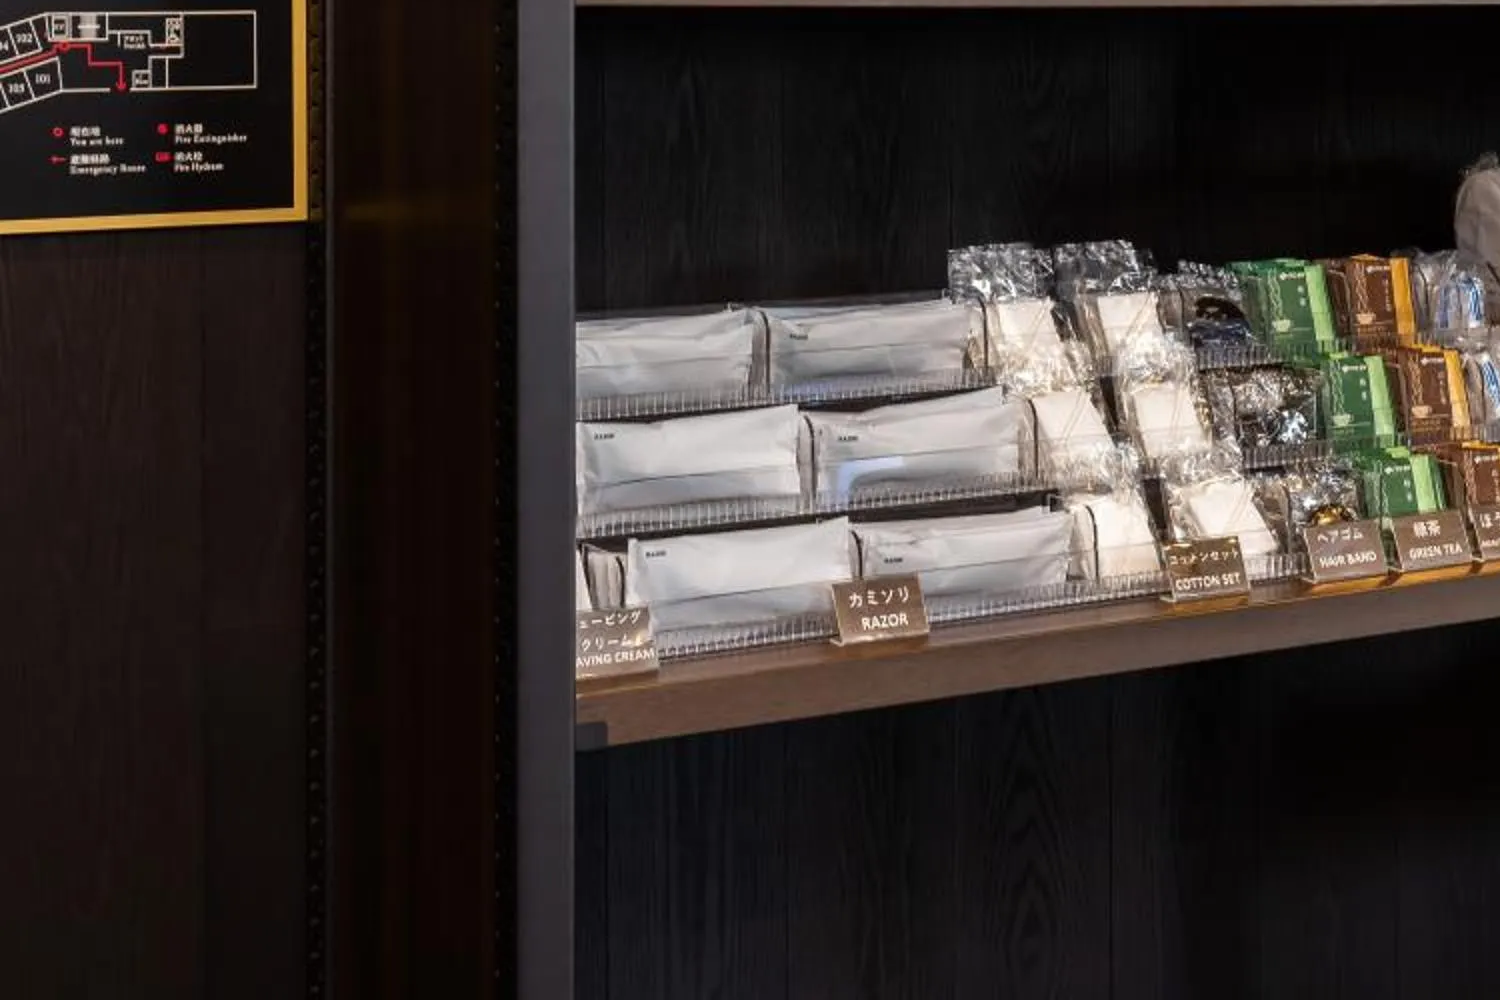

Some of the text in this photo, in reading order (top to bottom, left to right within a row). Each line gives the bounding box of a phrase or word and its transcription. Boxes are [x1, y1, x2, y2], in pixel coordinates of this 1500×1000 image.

[1317, 527, 1363, 543] ヘアゴム
[1409, 541, 1463, 560] GREEN TEA
[1319, 555, 1346, 568] HAIR
[1175, 571, 1241, 590] COTTON SET
[849, 587, 909, 608] カミソリ
[861, 613, 909, 630] RAZOR
[615, 648, 655, 663] CREAM
